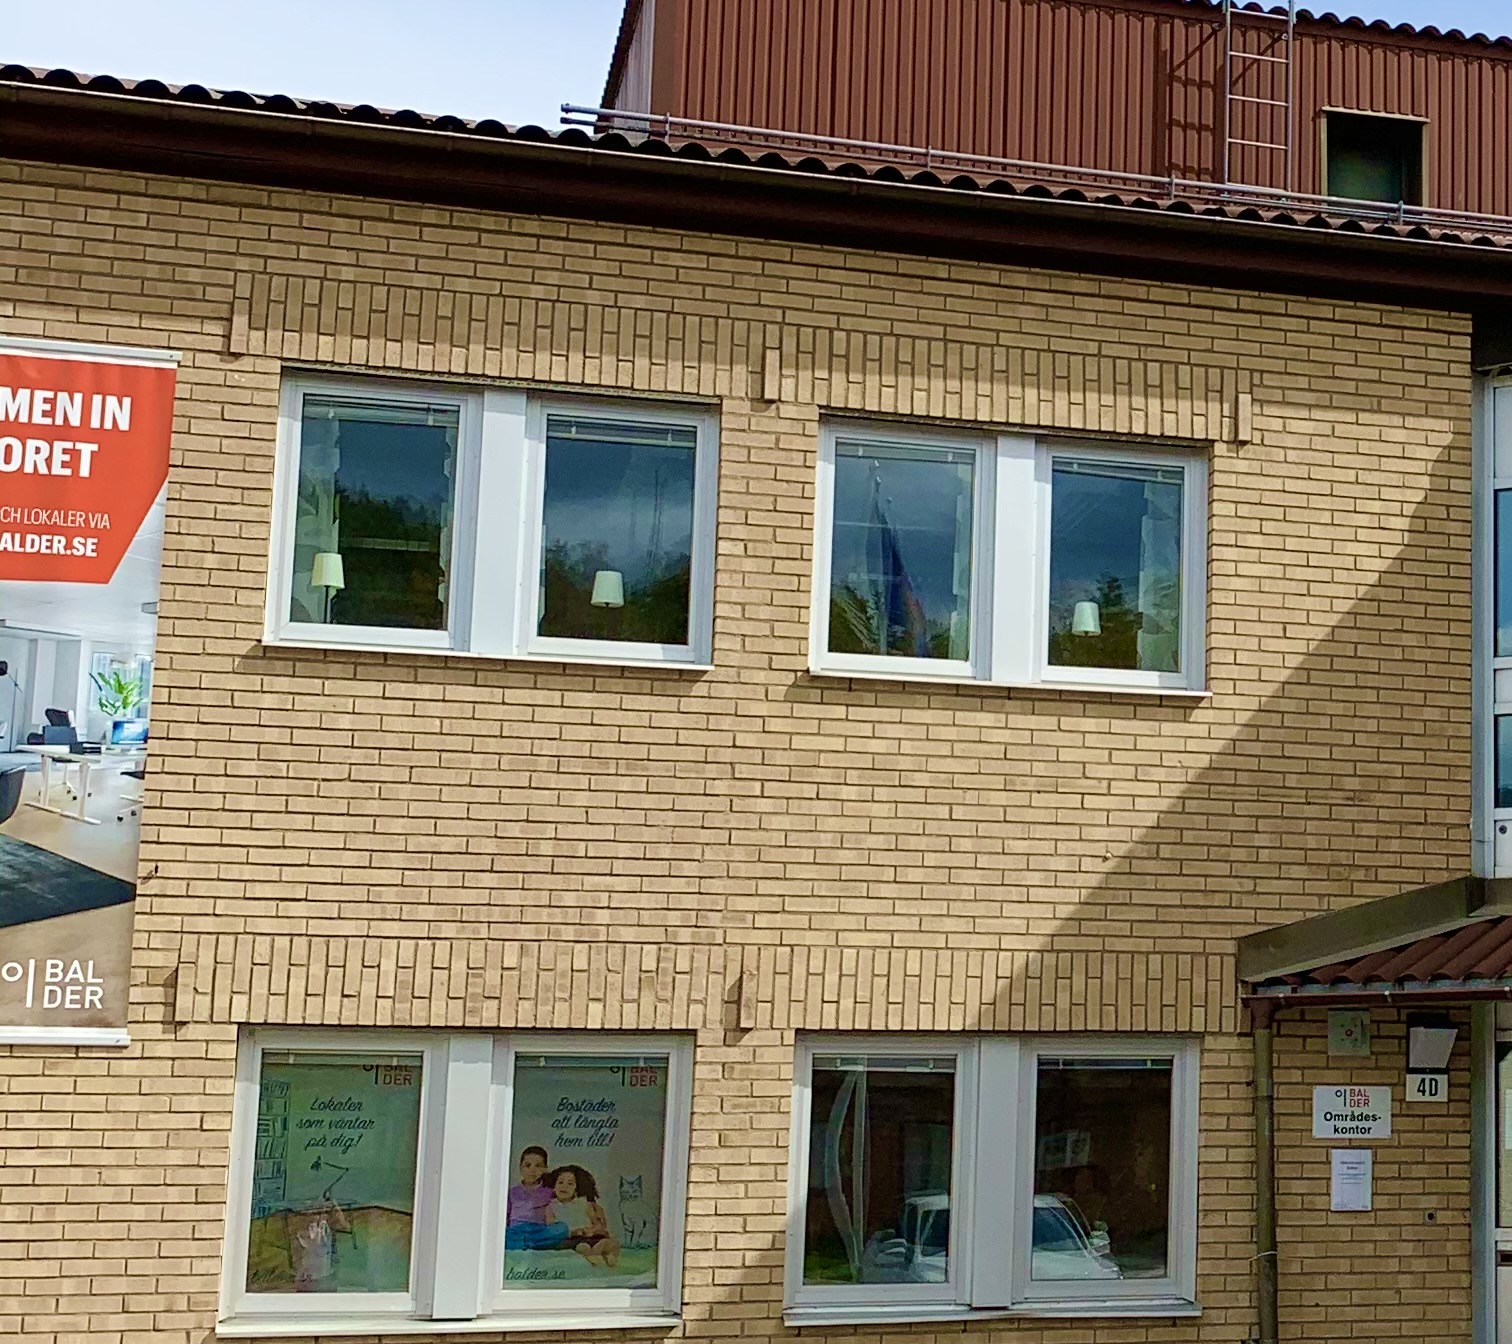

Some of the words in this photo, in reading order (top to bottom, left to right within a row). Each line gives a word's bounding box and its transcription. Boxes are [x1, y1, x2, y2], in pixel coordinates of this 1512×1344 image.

[90, 393, 132, 431] IN
[24, 508, 85, 527] LOKALER
[88, 512, 111, 530] VIA
[45, 959, 104, 983] BAL
[42, 985, 104, 1010] DER
[382, 1074, 413, 1086] DER
[629, 1075, 658, 1087] DER
[1417, 1077, 1439, 1097] 4D
[1349, 1088, 1370, 1098] BAL
[310, 1096, 364, 1112] Lokaler
[556, 1096, 617, 1112] Bostäder
[1349, 1098, 1370, 1108] DER
[296, 1118, 325, 1130] som
[328, 1115, 376, 1130] väntar
[1323, 1110, 1382, 1122] Områdes-
[551, 1115, 571, 1130] att
[573, 1114, 620, 1136] längta
[1333, 1124, 1373, 1135] kontor
[304, 1134, 327, 1152] på
[330, 1133, 364, 1155] dig!
[554, 1133, 583, 1148] hem
[586, 1133, 616, 1148] till!
